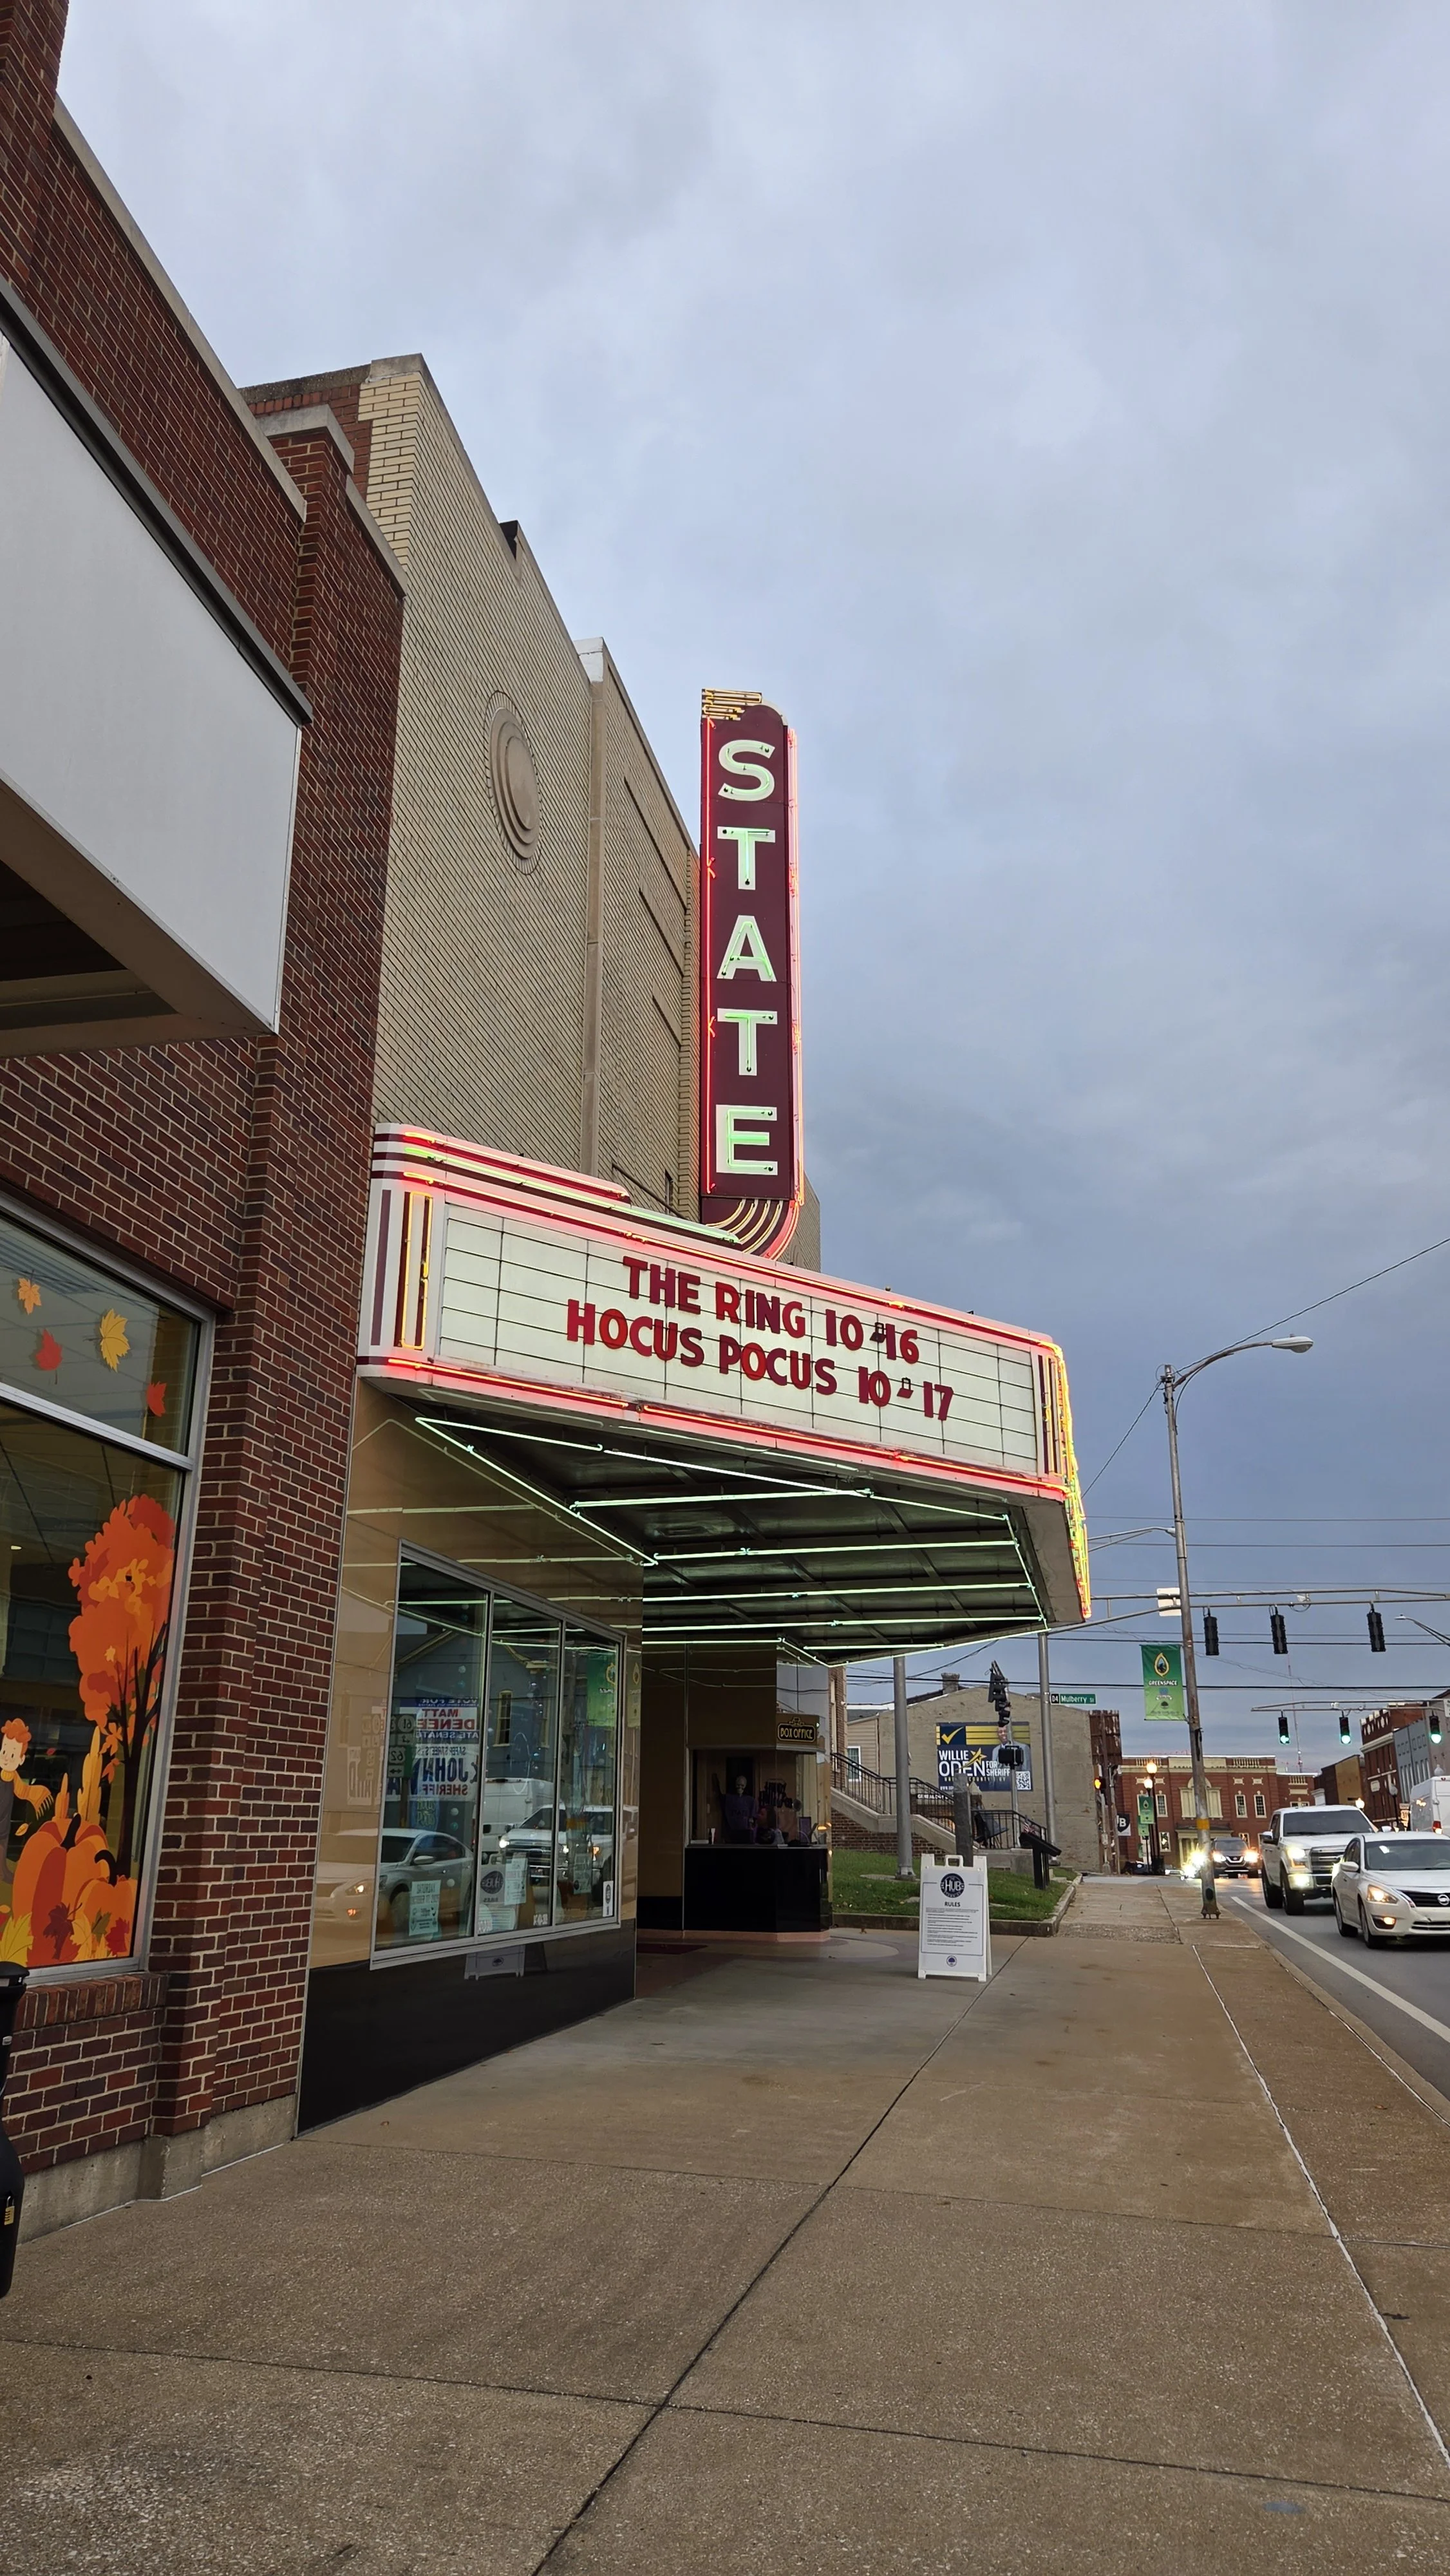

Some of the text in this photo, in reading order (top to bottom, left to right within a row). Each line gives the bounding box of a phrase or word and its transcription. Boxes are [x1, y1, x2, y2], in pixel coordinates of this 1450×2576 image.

[715, 739, 778, 1177] STATE
[623, 1256, 702, 1314] THE
[715, 1281, 806, 1338] RING
[567, 1298, 705, 1368] HOCUS
[719, 1334, 838, 1396] POCUS
[1060, 1695, 1087, 1703] Mulberry
[780, 1727, 813, 1739] BOX OFFICE
[939, 1750, 969, 1761] WILLIE
[986, 1760, 997, 1768] FOR
[986, 1768, 1010, 1777] SHERIFF
[945, 1879, 961, 1891] HUB
